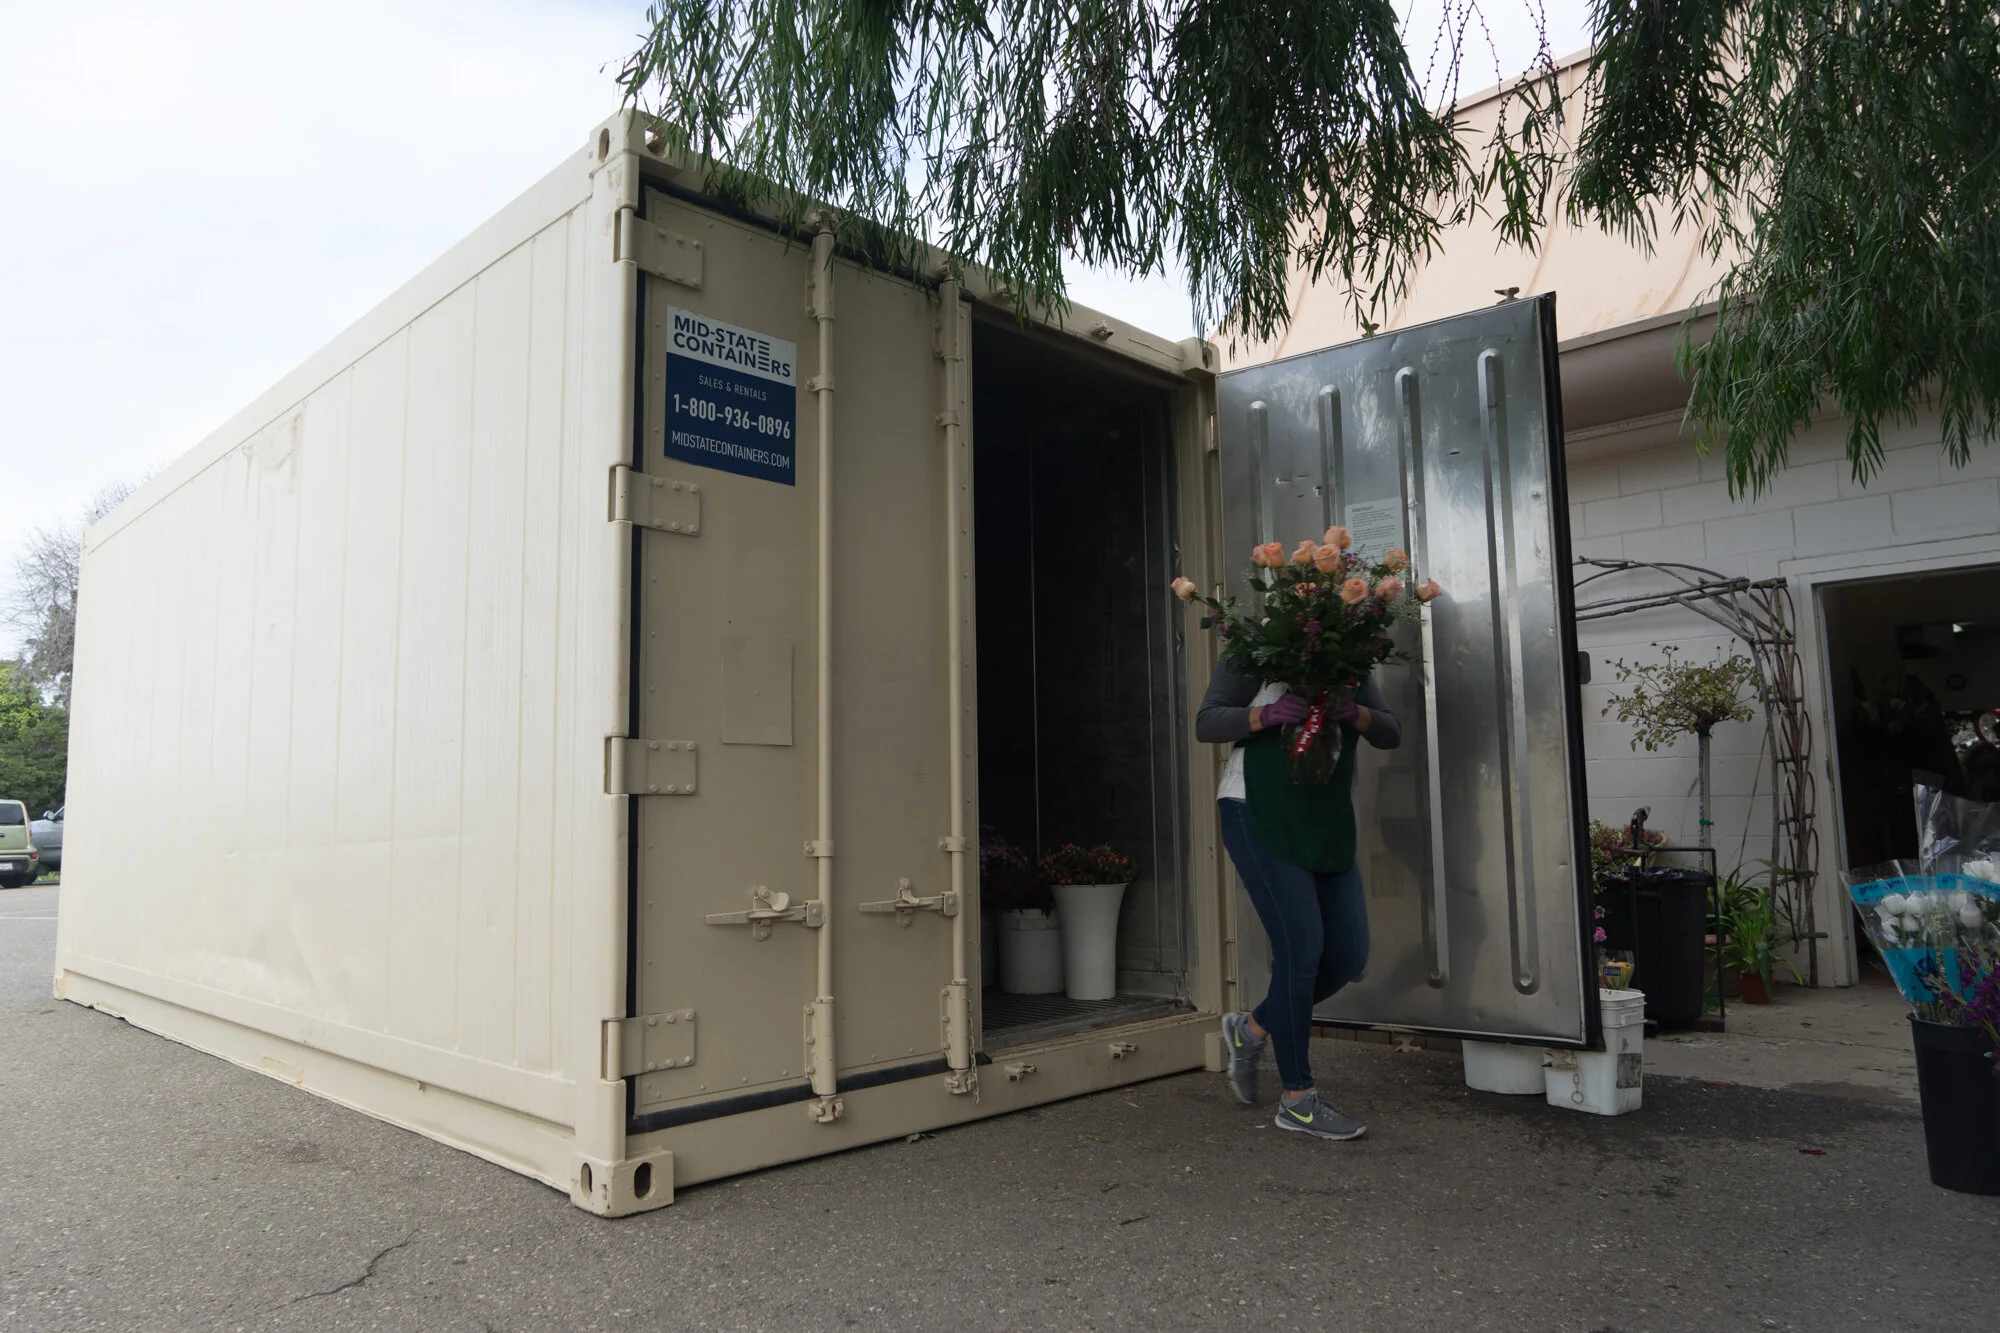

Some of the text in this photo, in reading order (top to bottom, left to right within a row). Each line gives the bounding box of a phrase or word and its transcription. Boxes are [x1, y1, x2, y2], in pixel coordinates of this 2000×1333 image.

[674, 314, 770, 352] MID-STATE
[673, 332, 791, 378] CONTAINERS
[699, 375, 767, 401] SALES & RENTALS
[673, 393, 791, 440] 1-800-936-0896
[672, 430, 790, 469] MIDSTATECONTAINERS.COM
